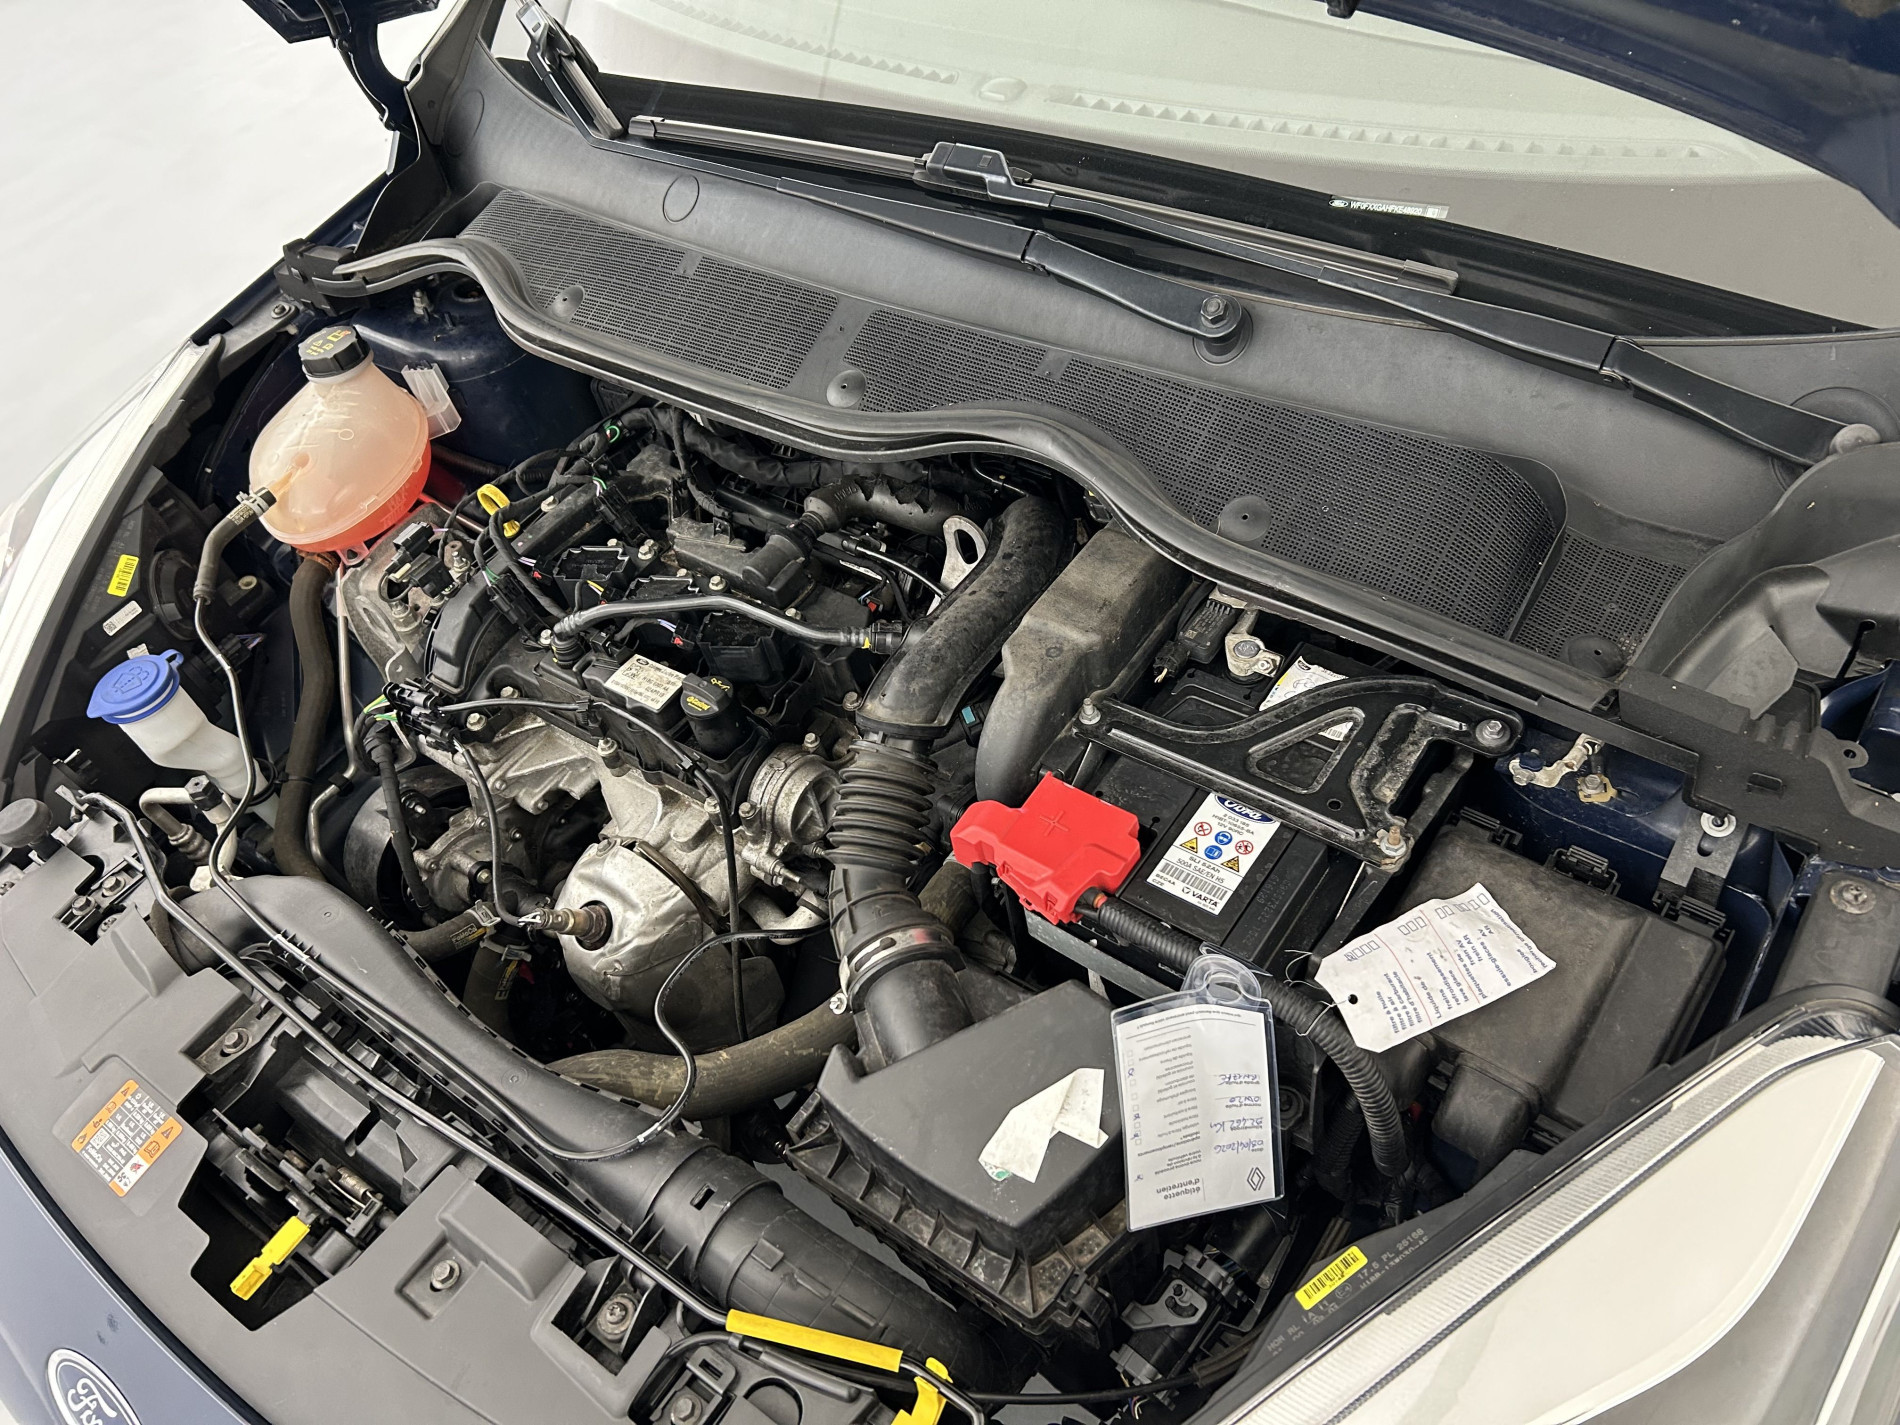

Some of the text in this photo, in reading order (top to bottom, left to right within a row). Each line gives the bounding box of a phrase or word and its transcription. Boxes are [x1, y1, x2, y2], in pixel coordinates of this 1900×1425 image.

[1176, 858, 1192, 868] 500A
[1192, 865, 1214, 878] SAE/EN
[1191, 891, 1218, 907] VARTA
[1477, 927, 1486, 937] AV
[1484, 924, 1493, 935] AR
[1455, 938, 1475, 965] frein AV
[1455, 952, 1464, 962] de
[1462, 934, 1482, 961] frein AR
[1480, 941, 1511, 985] essuie-glaces
[1516, 948, 1537, 973] bougies
[1383, 972, 1403, 1003] carburant
[1426, 952, 1460, 1004] refroidissement
[1447, 969, 1469, 1002] lave glace
[1462, 963, 1487, 998] plaquettes
[1375, 990, 1387, 1009] huile
[1386, 995, 1395, 1006] air
[1392, 971, 1422, 1022] filtre d'habitacle
[1418, 980, 1442, 1018] Liquide de
[1438, 988, 1452, 1009] freins
[1388, 1016, 1399, 1033] filtre
[1395, 1012, 1406, 1029] filtre
[1404, 1010, 1414, 1026] filtre
[1156, 1178, 1199, 1193] d'entretien
[1163, 1186, 1200, 1200] étiquette
[1357, 1261, 1379, 1280] 17.5
[1380, 1248, 1395, 1262] PL
